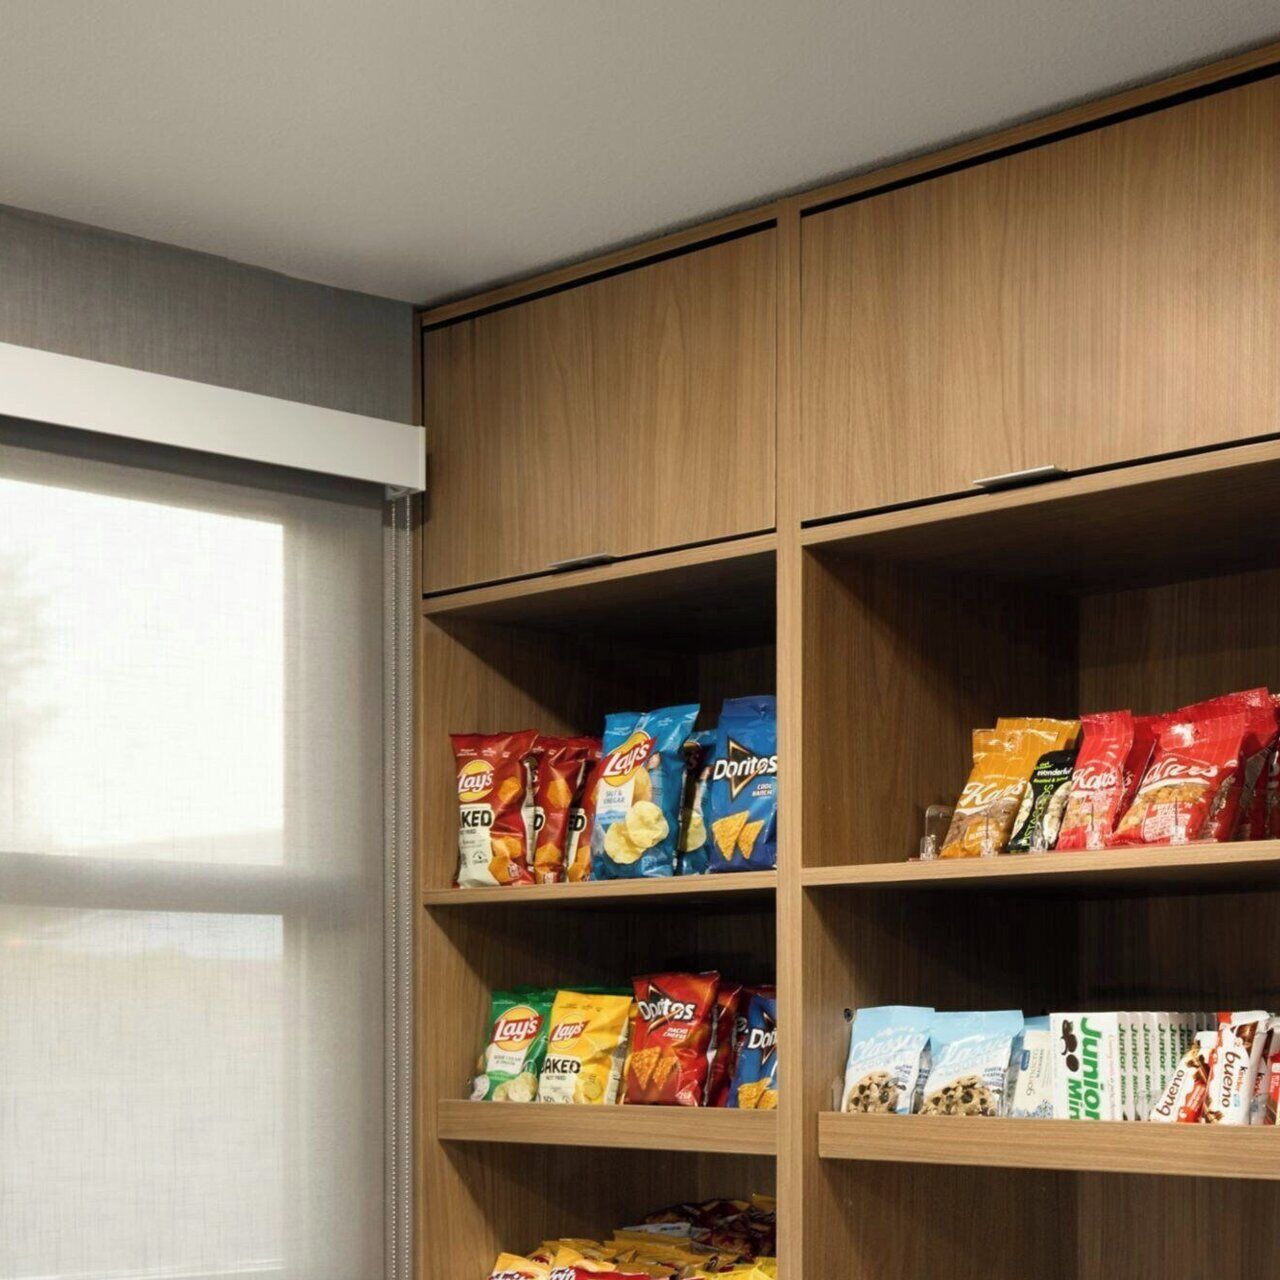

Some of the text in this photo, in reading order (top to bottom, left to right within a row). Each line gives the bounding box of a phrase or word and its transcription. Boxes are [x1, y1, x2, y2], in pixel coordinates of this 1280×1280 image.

[603, 741, 650, 778] Lay's
[713, 756, 777, 781] Doritos
[458, 770, 494, 793] Lay's
[461, 809, 493, 828] KED
[638, 999, 696, 1021] Doritos
[494, 1017, 539, 1042] Lay's
[552, 1021, 585, 1042] Lay's
[1222, 1050, 1241, 1108] bueno
[1068, 1078, 1083, 1120] Min
[1156, 1069, 1185, 1116] bueno
